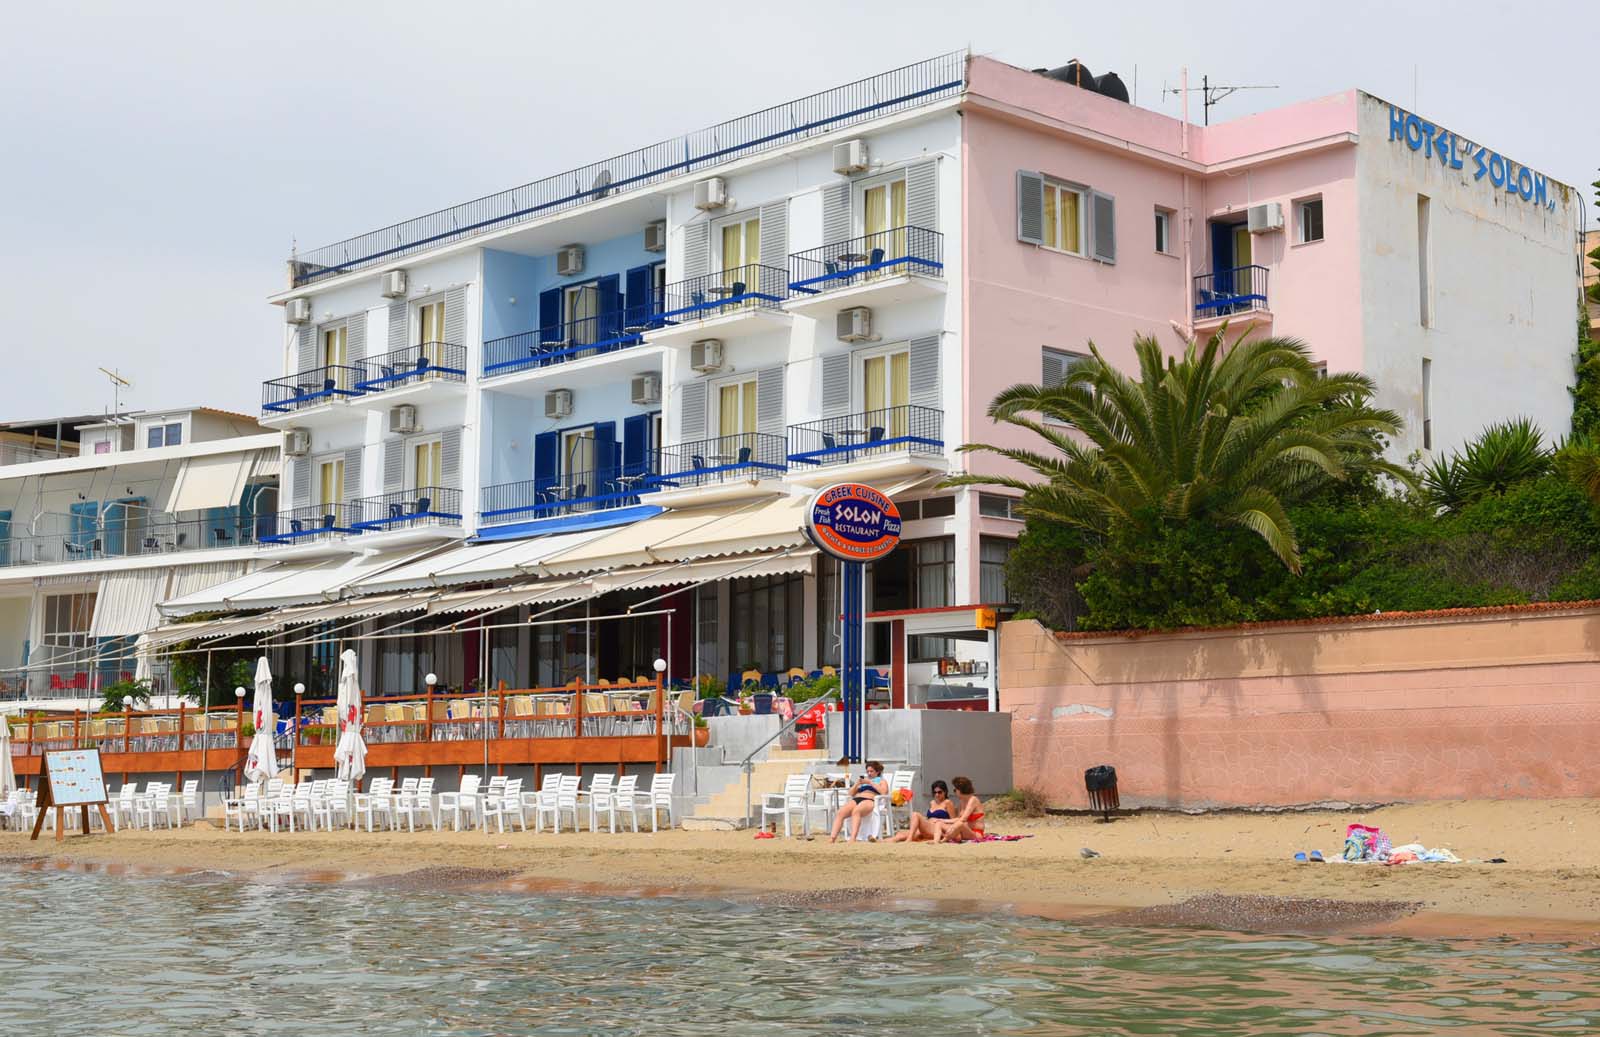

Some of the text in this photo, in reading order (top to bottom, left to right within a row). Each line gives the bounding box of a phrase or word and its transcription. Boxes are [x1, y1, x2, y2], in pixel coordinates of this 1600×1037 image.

[1389, 104, 1463, 170] HOTEL
[825, 487, 890, 512] GREEK CUISINE
[815, 507, 830, 515] Fresh
[835, 504, 880, 524] SOLON
[835, 522, 879, 536] RESTAURANT
[883, 519, 900, 532] Pizza
